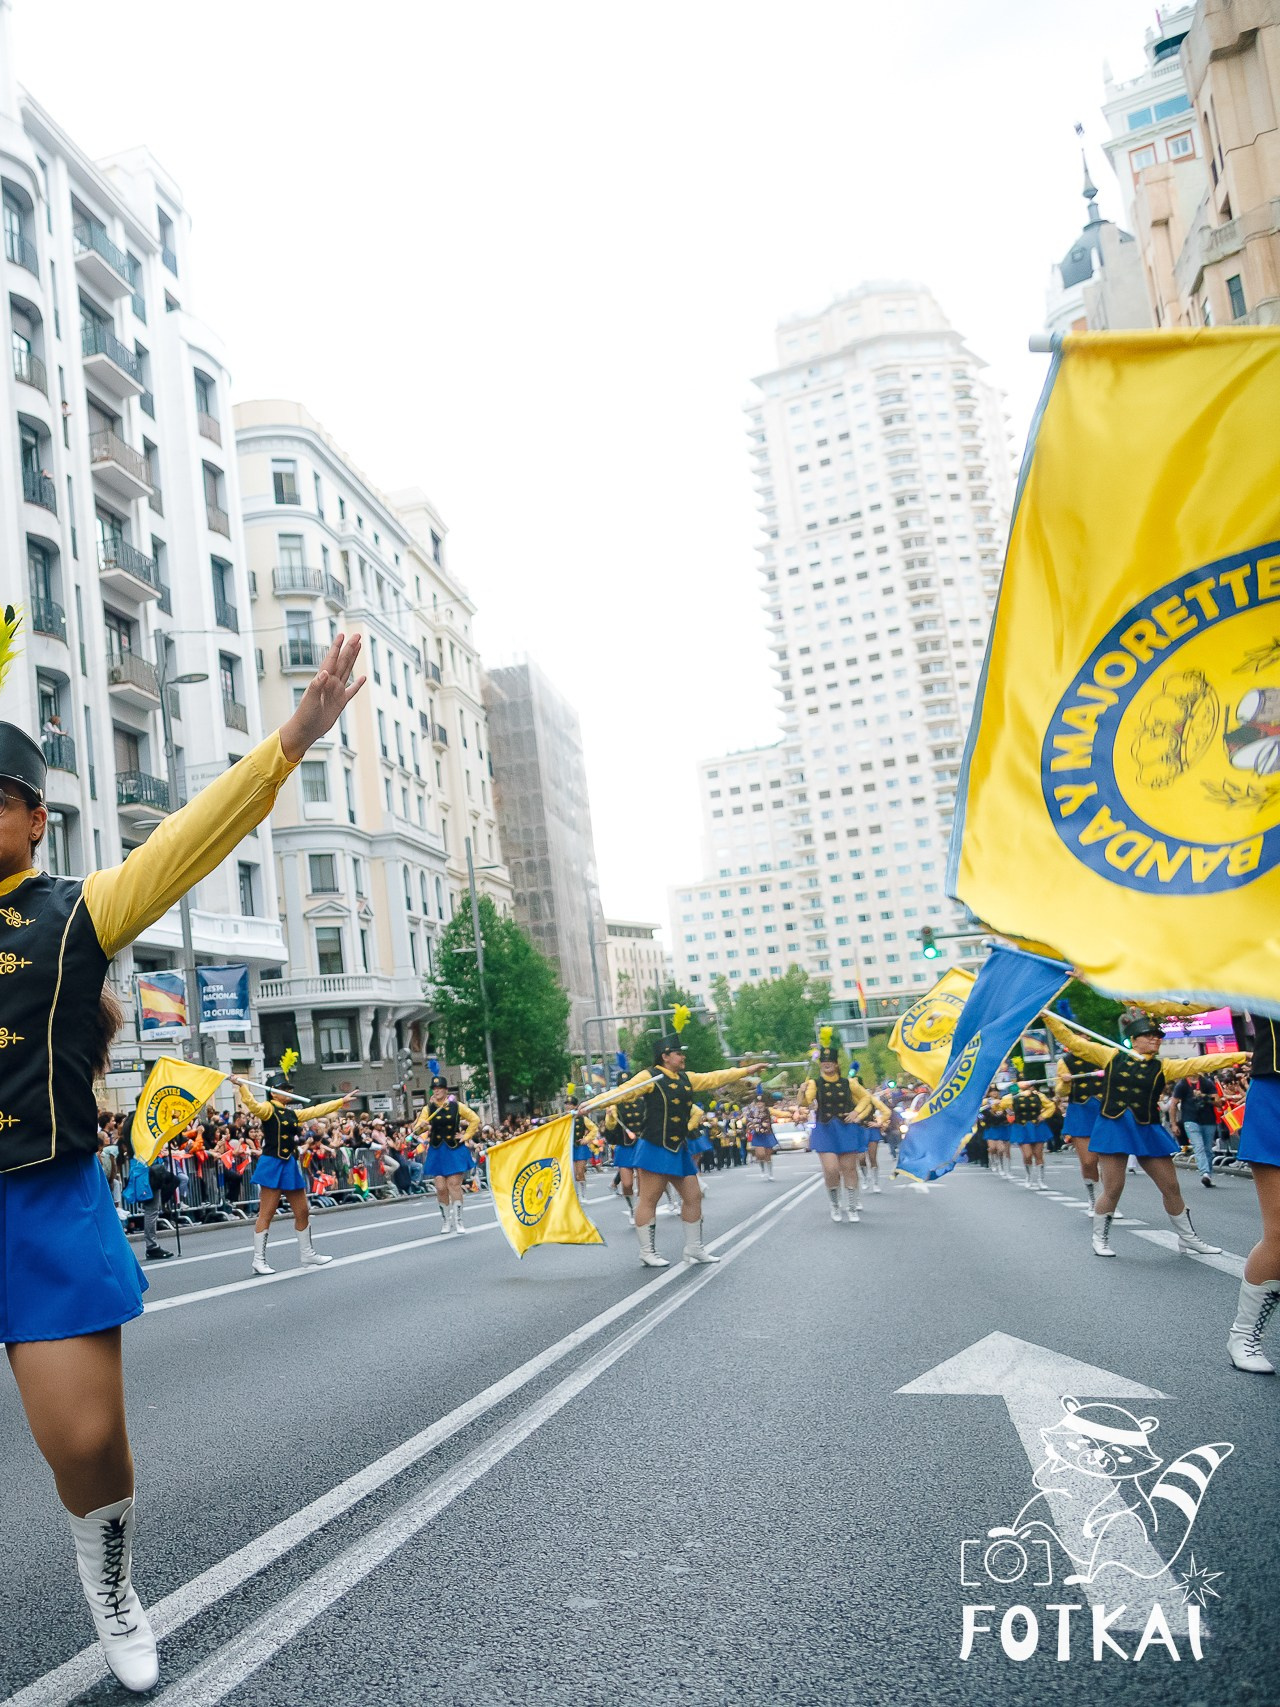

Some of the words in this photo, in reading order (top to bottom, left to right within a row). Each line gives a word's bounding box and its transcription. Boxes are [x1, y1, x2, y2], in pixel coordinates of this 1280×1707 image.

[1054, 781, 1098, 818] Y
[1078, 804, 1264, 884] BANDA
[203, 984, 224, 993] FIESTA
[203, 992, 238, 1001] NACIONAL
[212, 1008, 244, 1017] OCTUBRE
[148, 1087, 181, 1117] MAJORETTES
[513, 1162, 542, 1216] MAJORETTES
